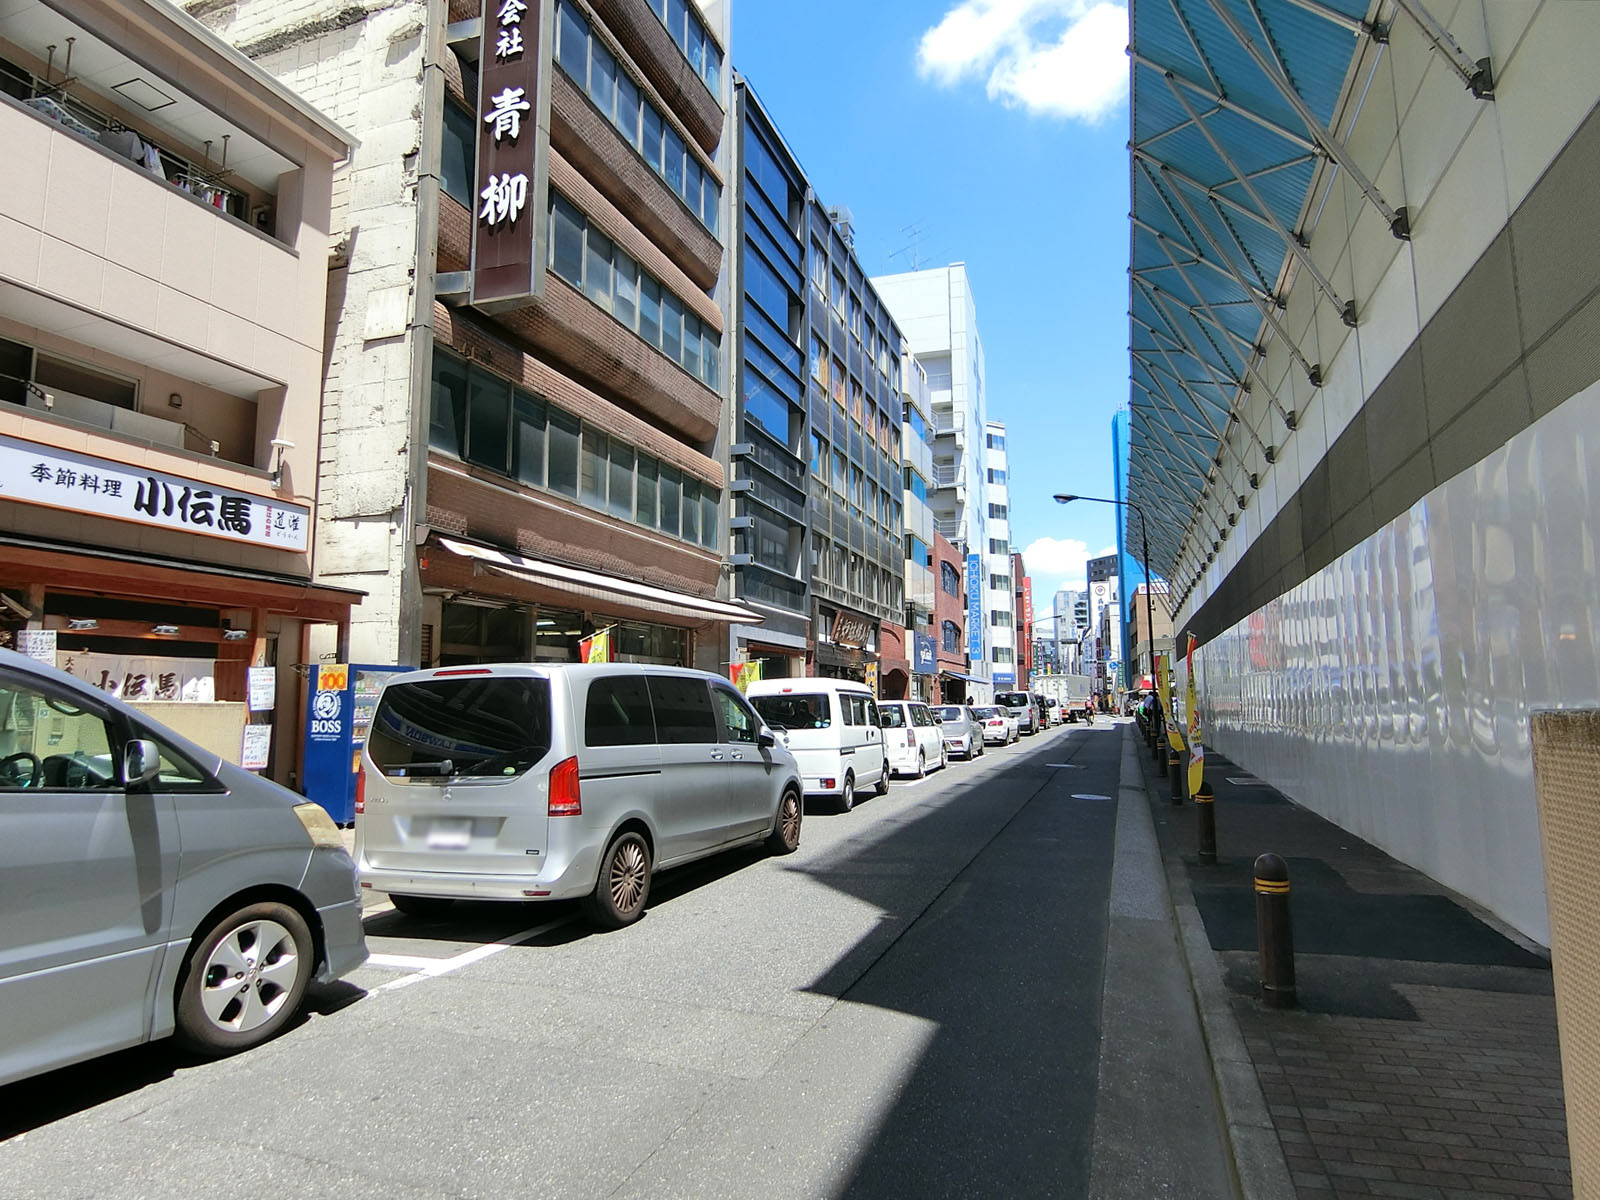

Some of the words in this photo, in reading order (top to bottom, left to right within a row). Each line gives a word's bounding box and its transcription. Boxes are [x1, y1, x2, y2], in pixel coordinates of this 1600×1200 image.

[30, 463, 123, 498] 季節料理
[134, 477, 252, 535] 小伝馬
[969, 602, 980, 645] MARKET
[320, 672, 347, 690] 100
[311, 720, 342, 733] BOSS
